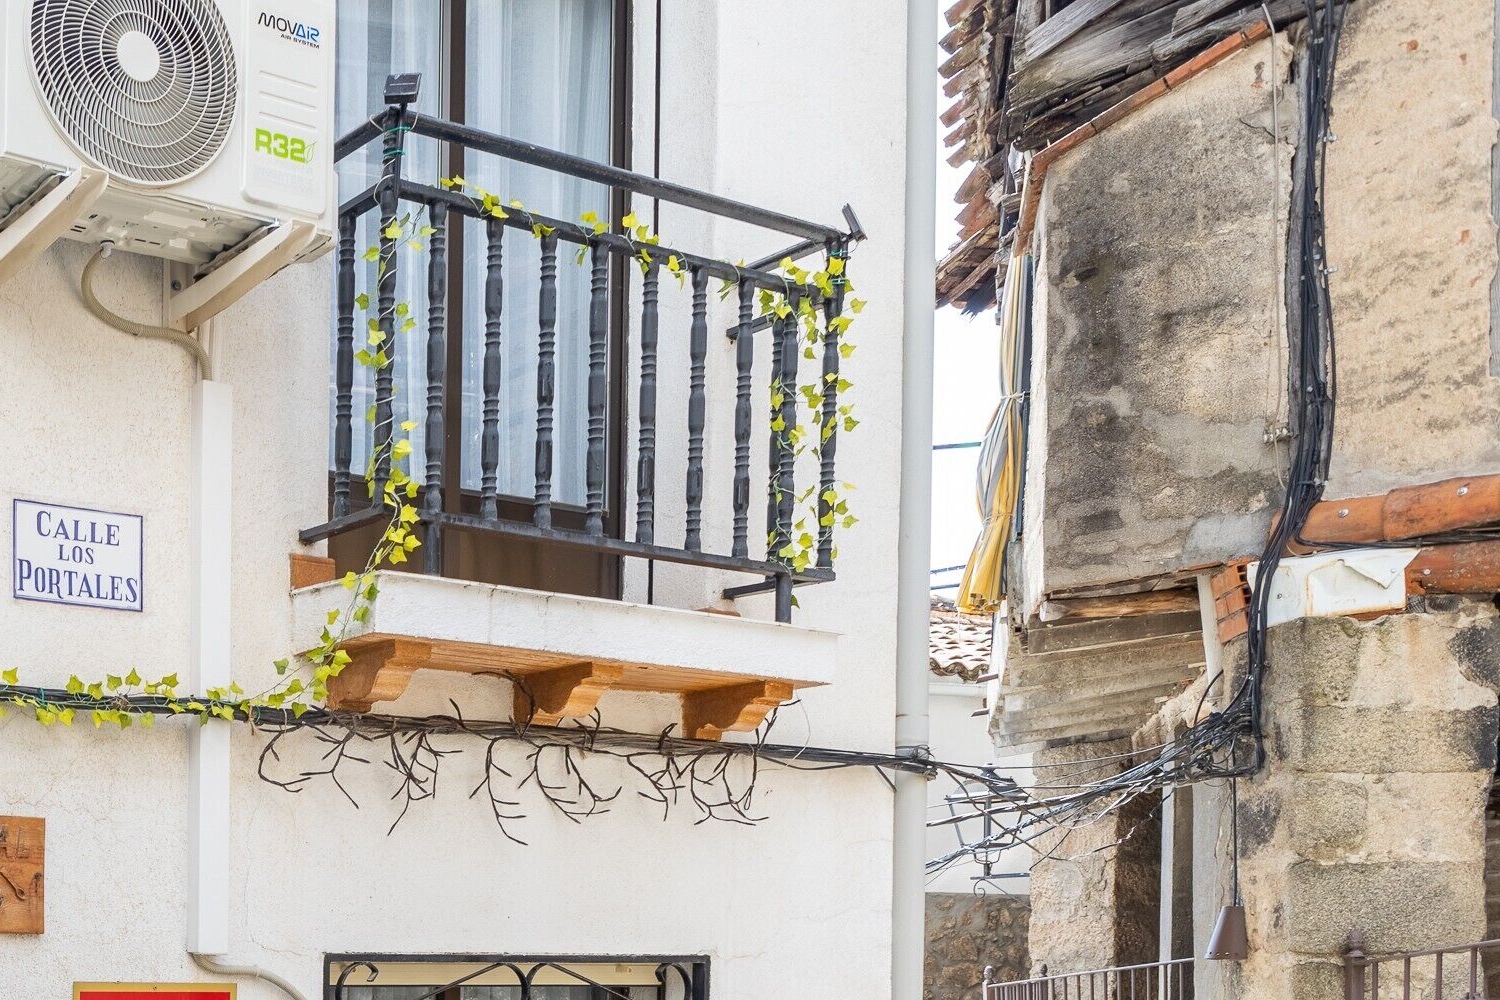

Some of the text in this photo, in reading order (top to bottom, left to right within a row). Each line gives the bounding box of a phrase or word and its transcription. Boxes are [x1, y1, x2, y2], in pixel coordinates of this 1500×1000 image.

[280, 33, 320, 49] AIR SYSTEM
[255, 128, 306, 163] R32
[36, 510, 120, 546] CALLE
[57, 544, 94, 565] LOS
[17, 558, 138, 603] PORTALES
